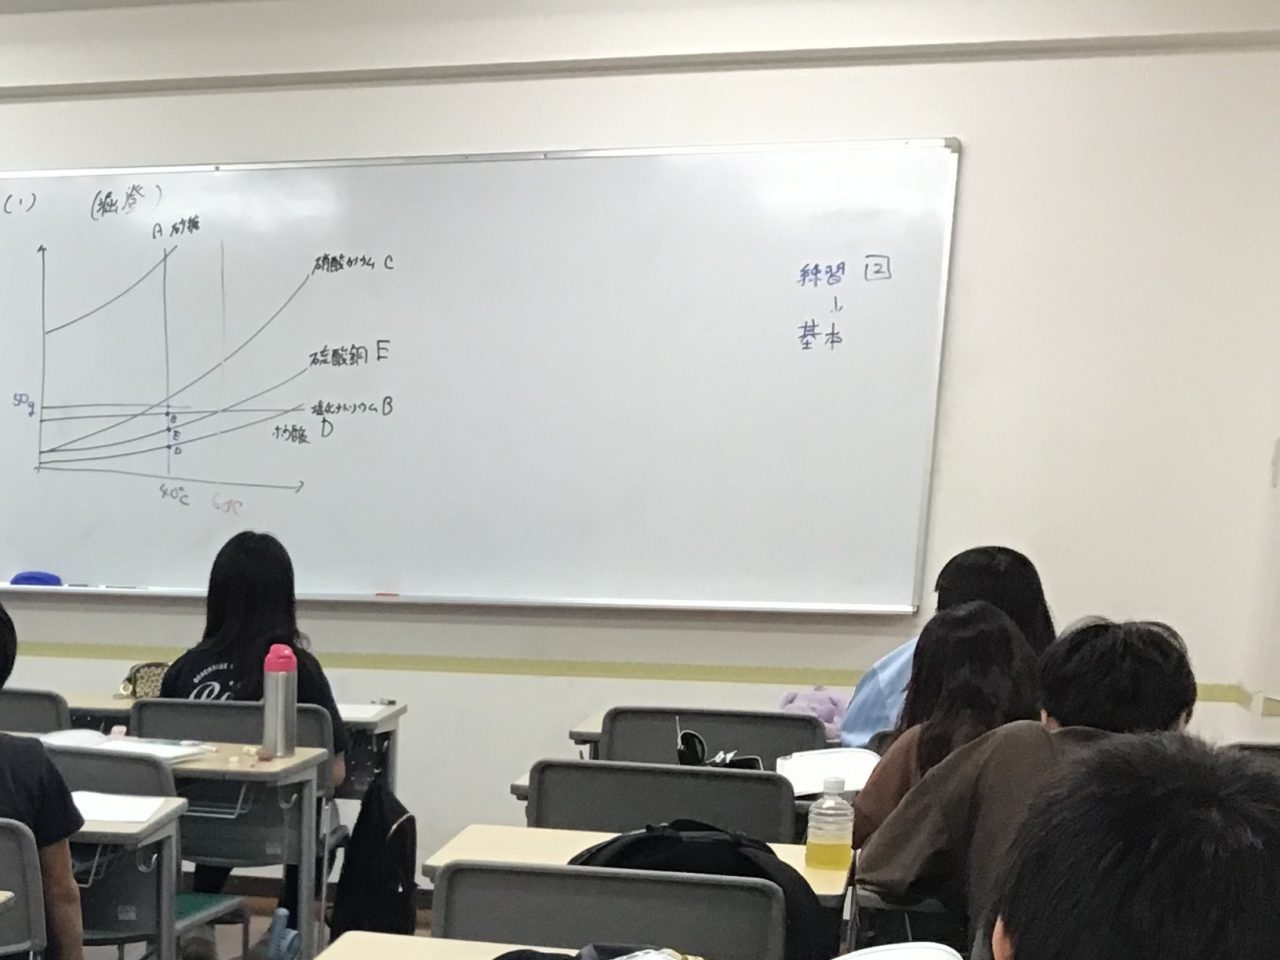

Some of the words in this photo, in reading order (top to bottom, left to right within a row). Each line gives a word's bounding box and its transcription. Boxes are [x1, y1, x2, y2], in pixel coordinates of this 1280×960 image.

[152, 223, 163, 239] A
[384, 254, 394, 270] C
[797, 261, 846, 287] 練習
[797, 318, 843, 350] 基本
[309, 344, 369, 367] 硫酸銅
[376, 339, 390, 361] E
[13, 392, 35, 417] 50g
[381, 395, 394, 417] B
[320, 416, 334, 438] D
